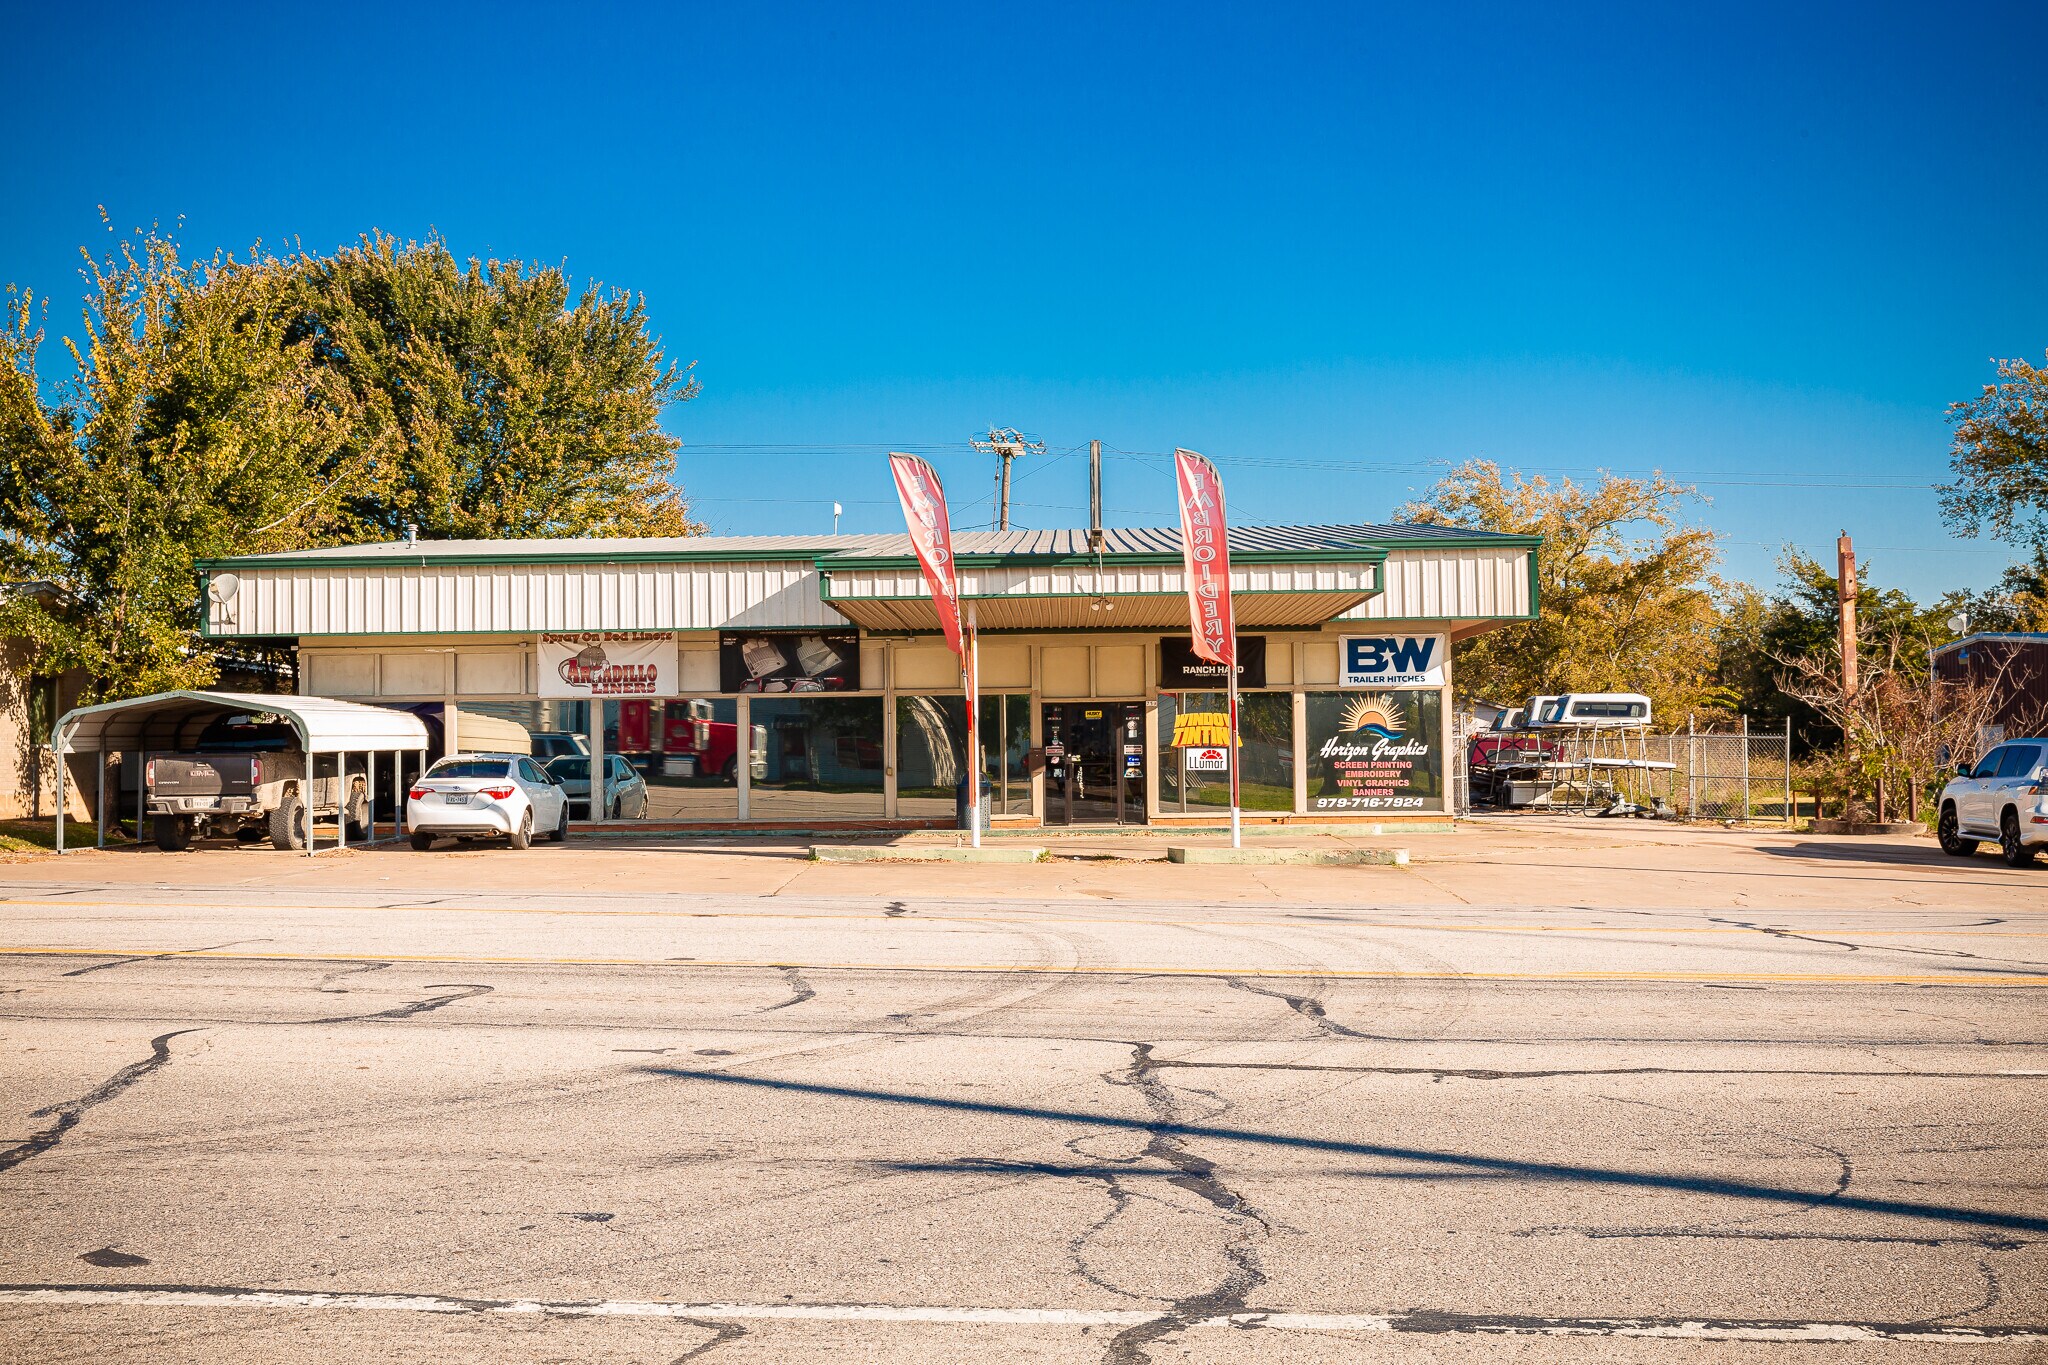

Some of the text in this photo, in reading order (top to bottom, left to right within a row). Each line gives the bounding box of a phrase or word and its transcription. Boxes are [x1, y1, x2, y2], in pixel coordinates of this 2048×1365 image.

[542, 631, 673, 643] Spray On Bed Liners
[1182, 666, 1245, 674] RANCH HAD
[1387, 675, 1426, 683] HITCHES
[591, 682, 657, 694] LINERS
[1171, 727, 1243, 747] TINTIN
[1320, 736, 1428, 761] Horizon Graphics
[1189, 757, 1224, 769] LLumar
[1334, 761, 1412, 769] SCREEN PRINTING
[1345, 770, 1402, 778] EMBROIDERY
[1337, 779, 1410, 787] VINYL GRAPHICS
[1353, 788, 1394, 796] BANNERS
[1317, 797, 1424, 808] 979-716-7924
